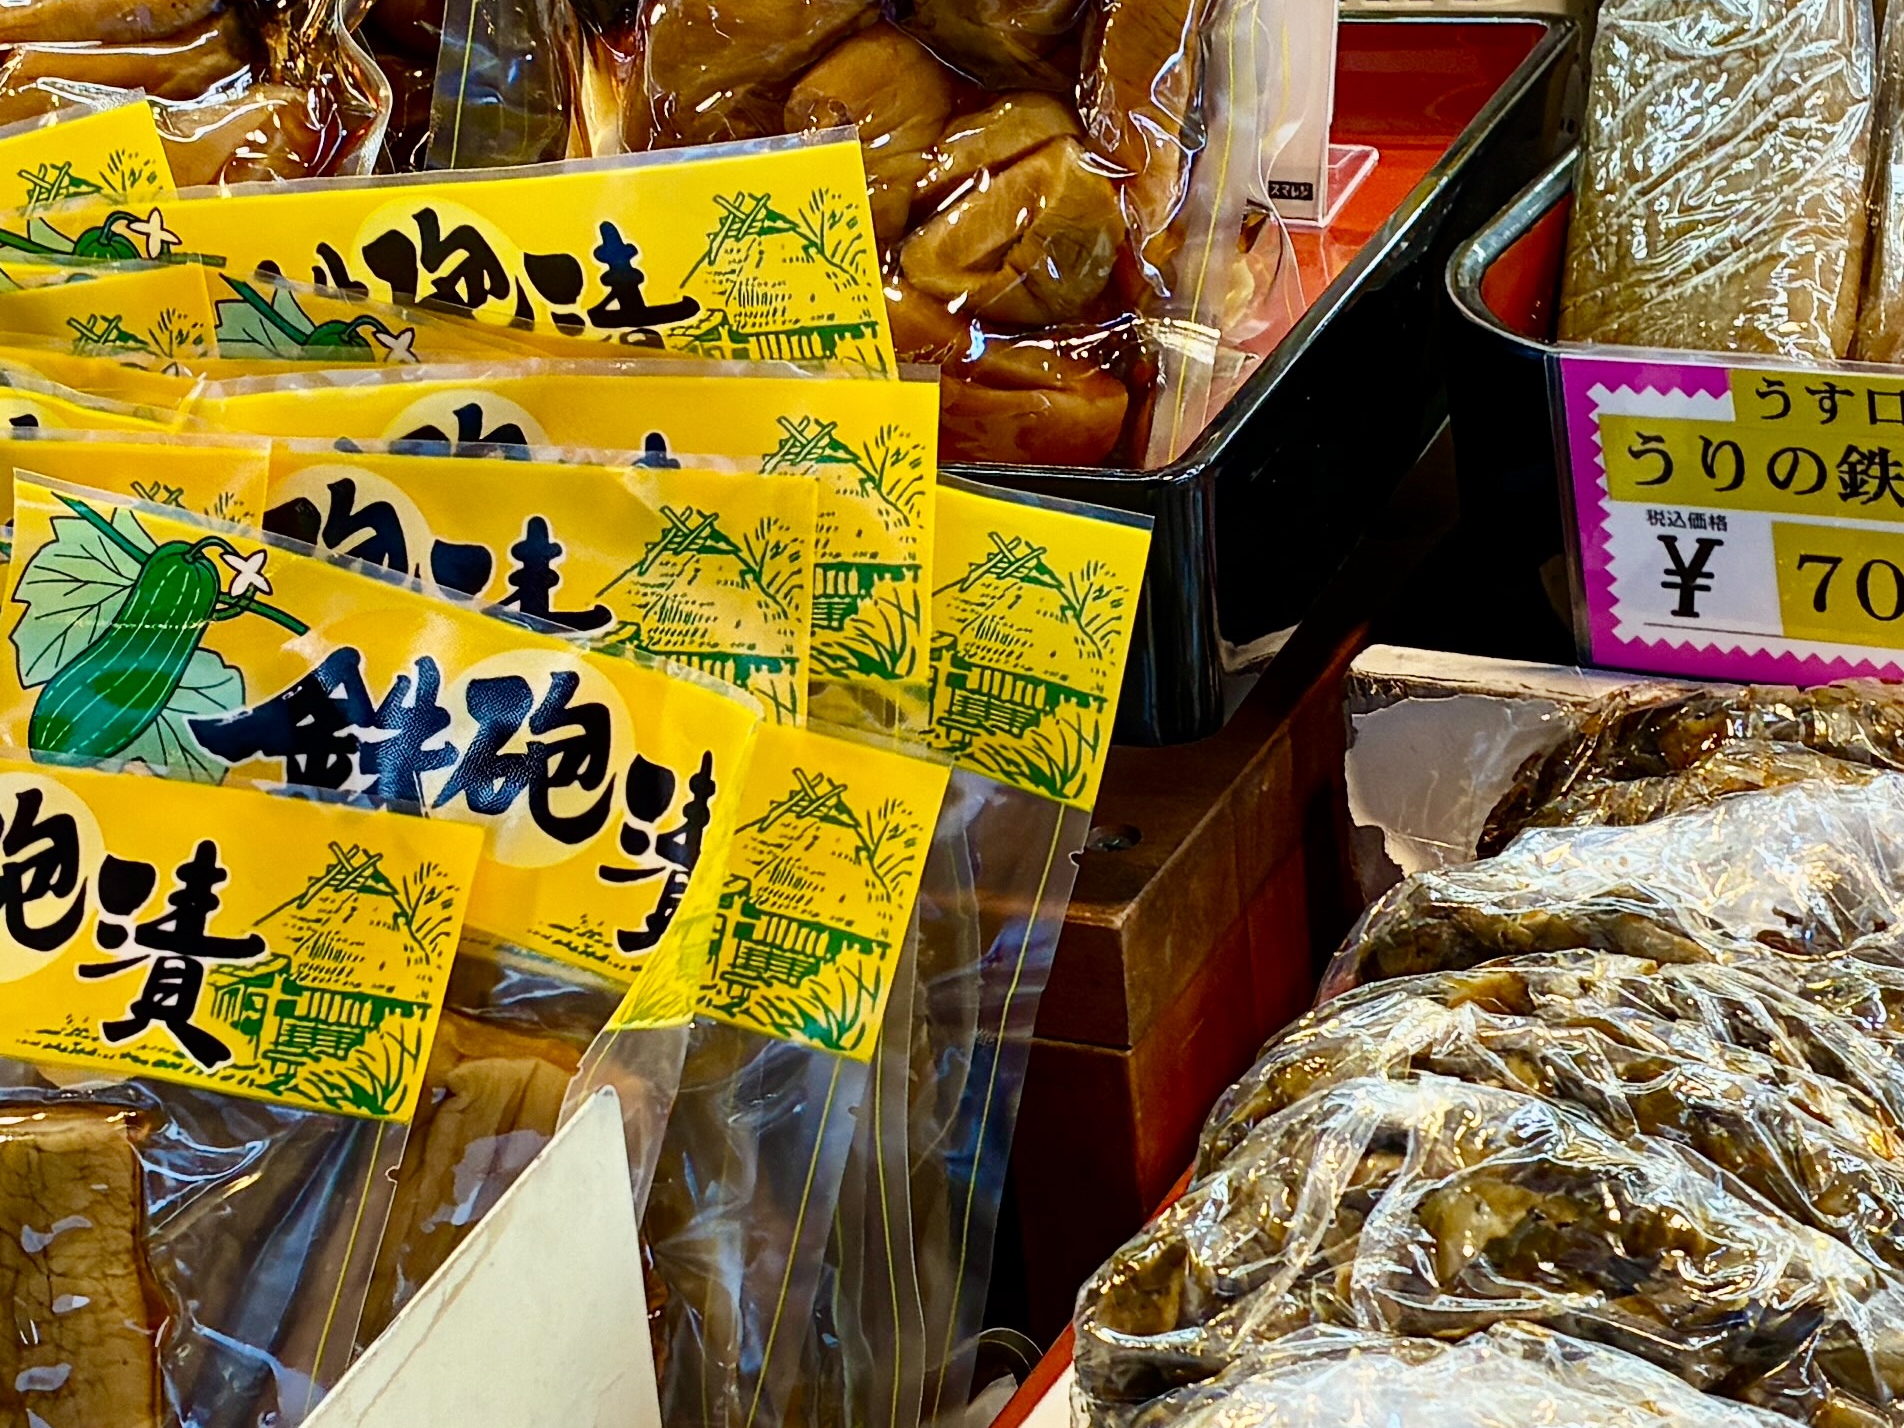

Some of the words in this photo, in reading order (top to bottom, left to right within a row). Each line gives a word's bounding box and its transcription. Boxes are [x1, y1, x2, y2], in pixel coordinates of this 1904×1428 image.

[1645, 507, 1729, 533] 税込価格
[1656, 533, 1725, 618] ¥
[183, 644, 718, 955] 鉄砲漬
